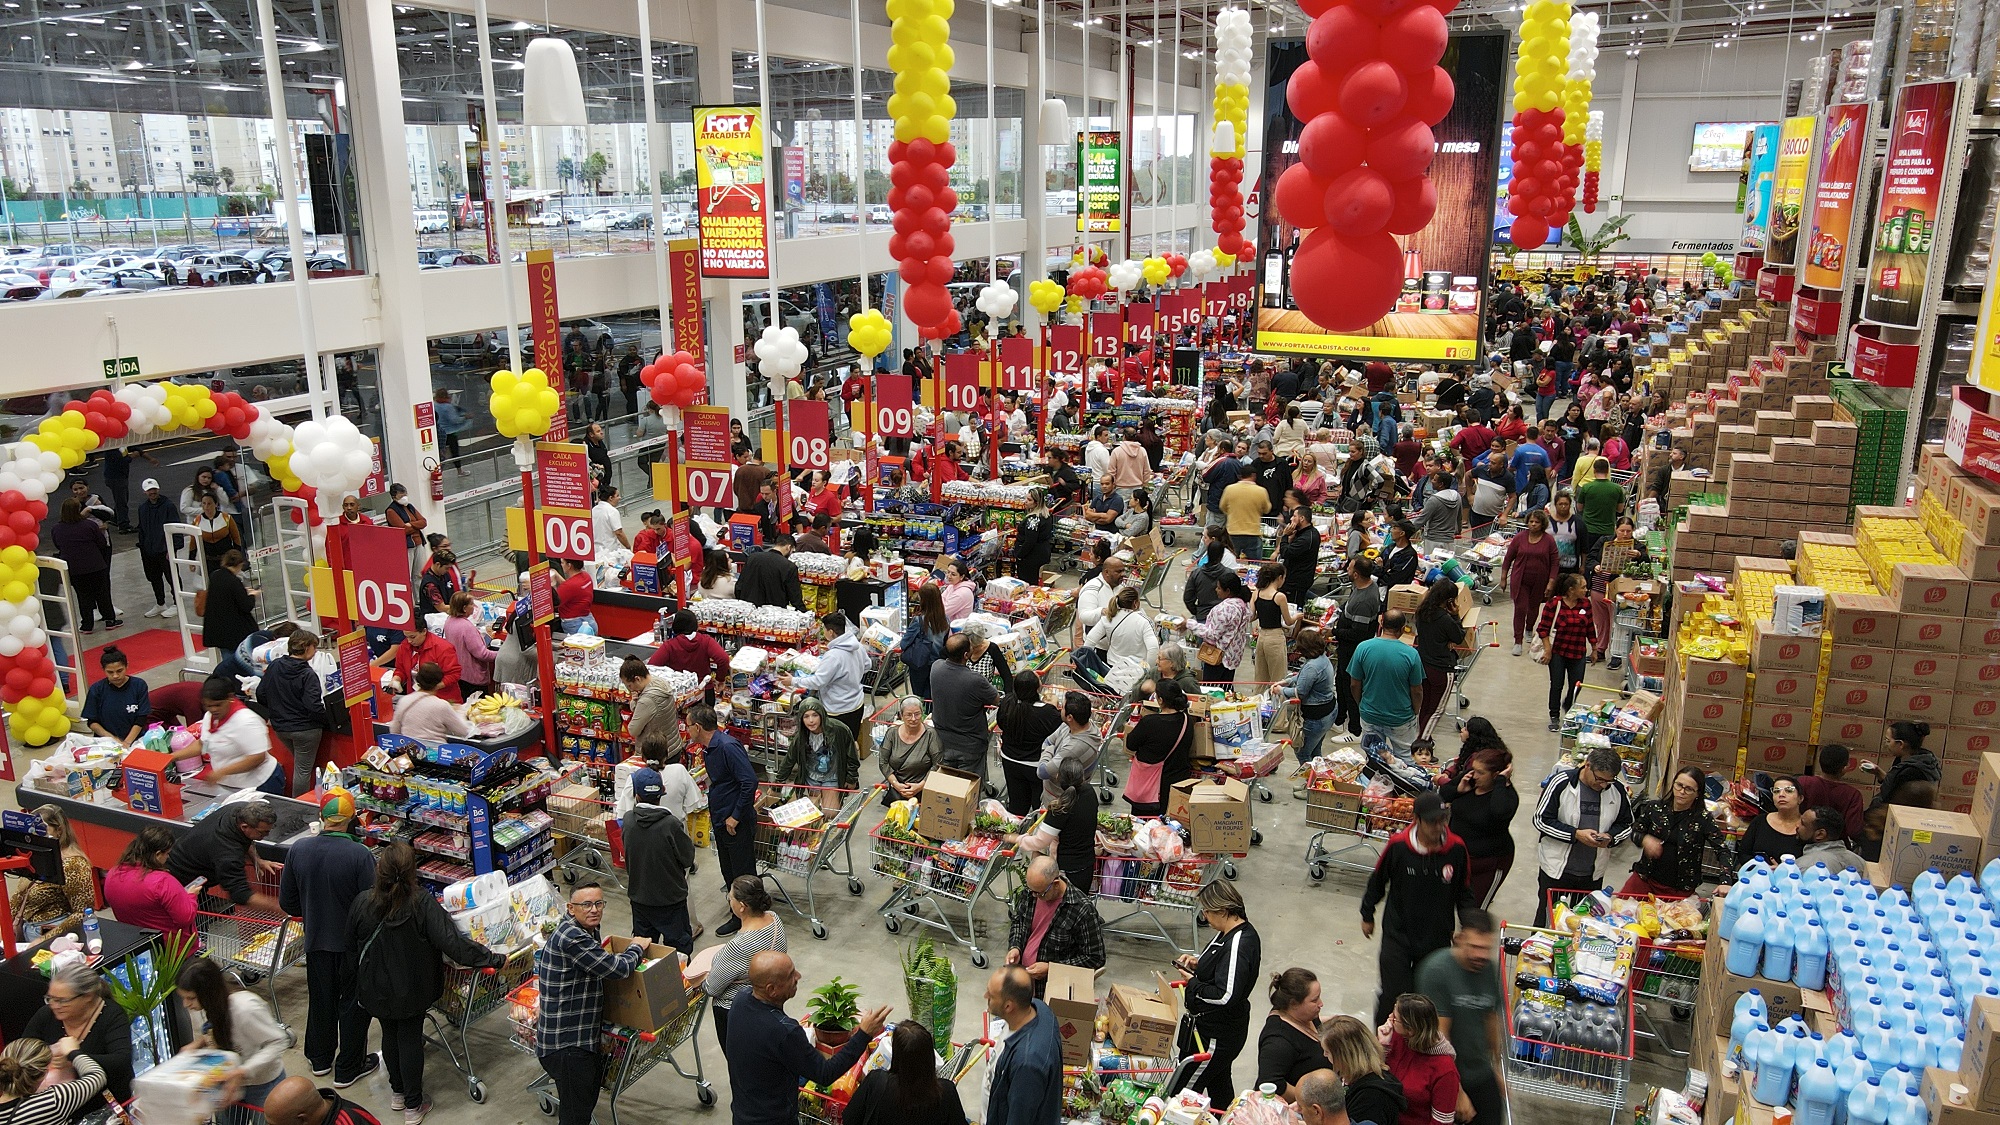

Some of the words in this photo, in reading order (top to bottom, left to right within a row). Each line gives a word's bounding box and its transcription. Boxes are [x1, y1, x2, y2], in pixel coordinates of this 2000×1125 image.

[706, 115, 749, 131] Fort
[1442, 141, 1480, 153] mesa
[1782, 138, 1809, 155] ABOCLO
[1088, 165, 1115, 173] RUTAS
[702, 217, 764, 227] QUALIDADE,
[703, 228, 763, 238] VARIEDADE
[703, 239, 708, 248] E
[710, 239, 765, 249] ECONOMIA,
[1671, 240, 1734, 251] Fermentados
[703, 250, 716, 258] NO
[718, 249, 764, 259] ATACADO
[704, 260, 708, 268] E
[710, 260, 723, 268] NO
[727, 260, 766, 269] VAREJO.
[684, 252, 700, 359] EXCLUSIVO
[1228, 293, 1246, 308] 18
[1207, 300, 1227, 317] 17
[1183, 308, 1200, 325] 16
[541, 264, 560, 388] EXCLUSIVO
[1161, 315, 1181, 332] 15
[678, 317, 688, 350] AIXA
[1129, 325, 1152, 343] 14
[1094, 336, 1118, 356] 13
[1262, 341, 1371, 352] WWW.FORTATACADISTA.COM.BR
[1053, 351, 1078, 372] 12
[1005, 365, 1032, 388] 11
[948, 384, 979, 409] 10
[878, 407, 911, 434] 09
[791, 437, 828, 466] 08
[548, 459, 577, 467] EXCLUSIVO
[689, 470, 730, 503] 07
[546, 517, 592, 556] 06
[358, 579, 411, 625] 05
[1919, 605, 1949, 613] TORRADAS
[1853, 637, 1883, 645] TORRADAS
[1845, 672, 1875, 680] TORRADAS
[1909, 678, 1939, 686] TORRADAS
[1702, 687, 1731, 695] TORRADAS
[1904, 713, 1934, 721] TORRADAS
[1930, 854, 1973, 864] AMACIANTE
[1942, 862, 1972, 871] ROUPAS
[1617, 935, 1633, 947] 24
[1581, 941, 1615, 955] Qualité
[1766, 1004, 1799, 1014] ACIANTE
